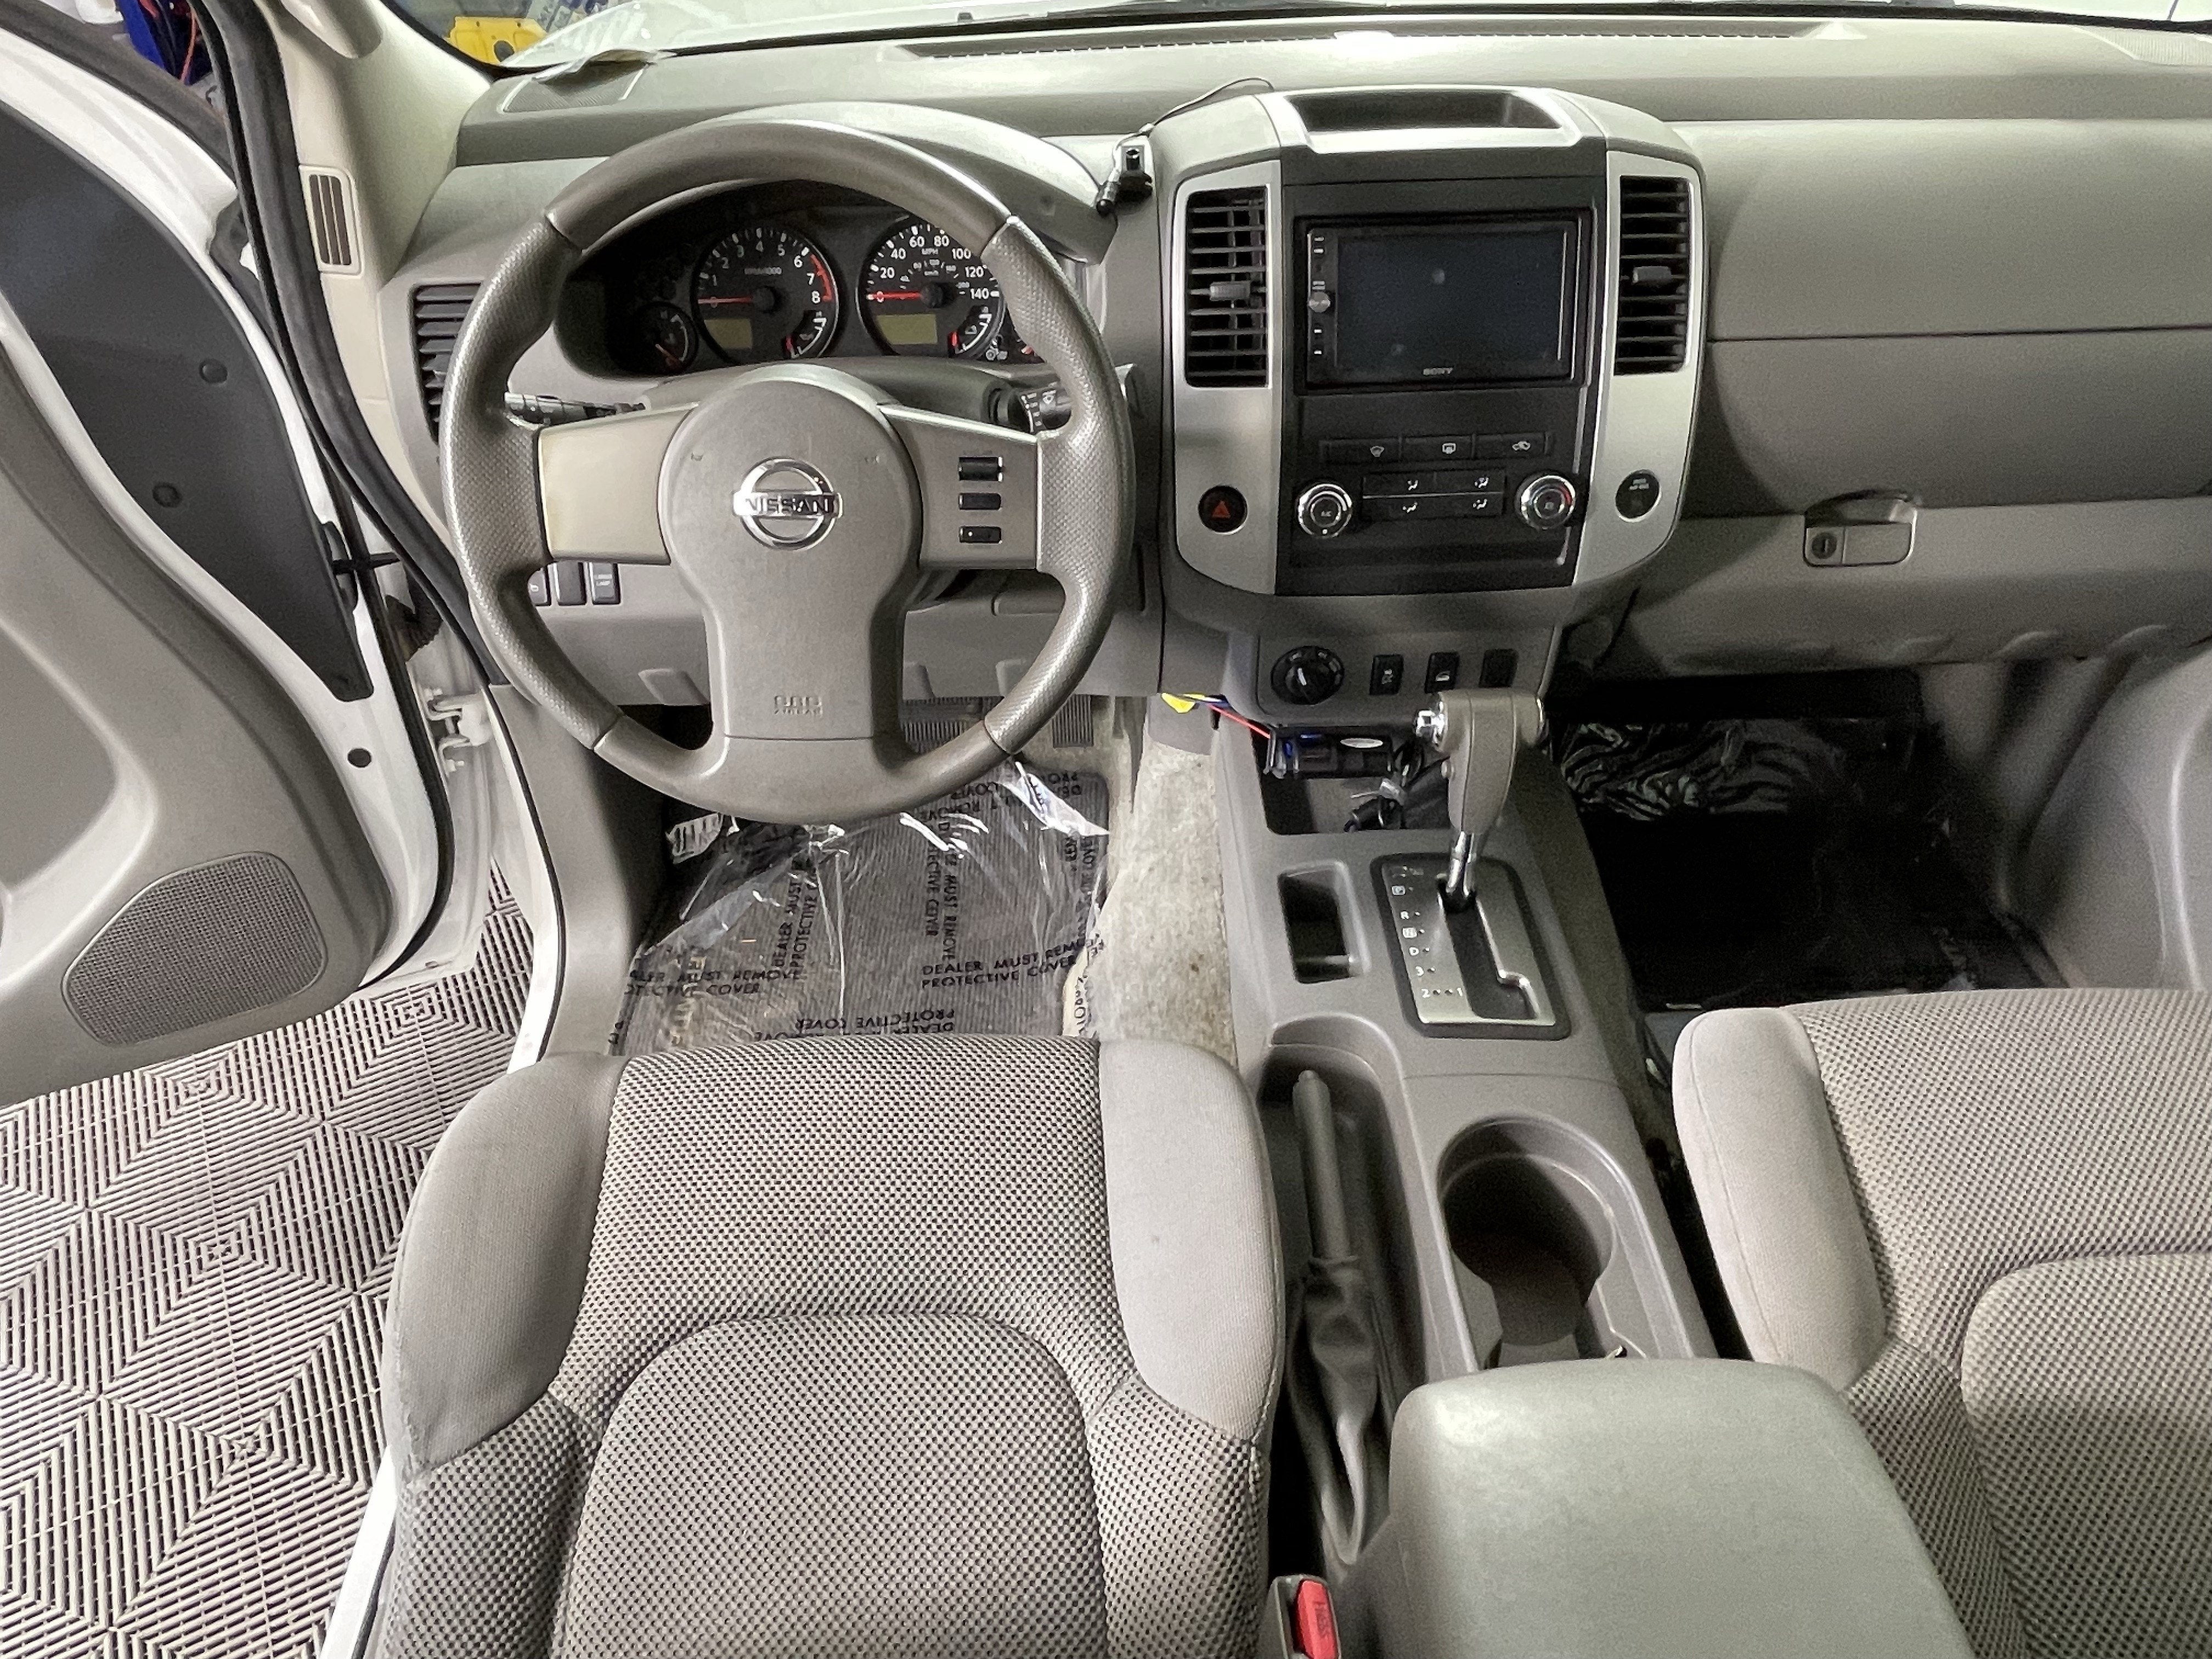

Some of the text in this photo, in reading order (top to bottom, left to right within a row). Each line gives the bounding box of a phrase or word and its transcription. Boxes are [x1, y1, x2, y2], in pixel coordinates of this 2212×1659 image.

[909, 235, 925, 247] 60
[934, 235, 950, 246] 80
[777, 245, 786, 257] 5
[890, 247, 906, 259] 40
[951, 248, 972, 259] 100
[722, 257, 730, 269] 2
[793, 255, 803, 268] 6
[879, 267, 895, 279] 20
[964, 266, 985, 278] 120
[712, 274, 718, 286] 1
[806, 272, 815, 285] 7
[811, 291, 821, 303] 8
[970, 287, 989, 300] 140
[745, 497, 830, 514] NISSAN
[1409, 946, 1419, 956] D
[923, 960, 983, 975] DEALER
[994, 952, 1039, 969] MUST
[1415, 966, 1424, 977] 3
[922, 970, 1019, 988] PROTECTIVE
[706, 983, 760, 995] COVER
[1421, 988, 1463, 998] 2 1
[856, 1008, 955, 1028] PROTECTIVE
